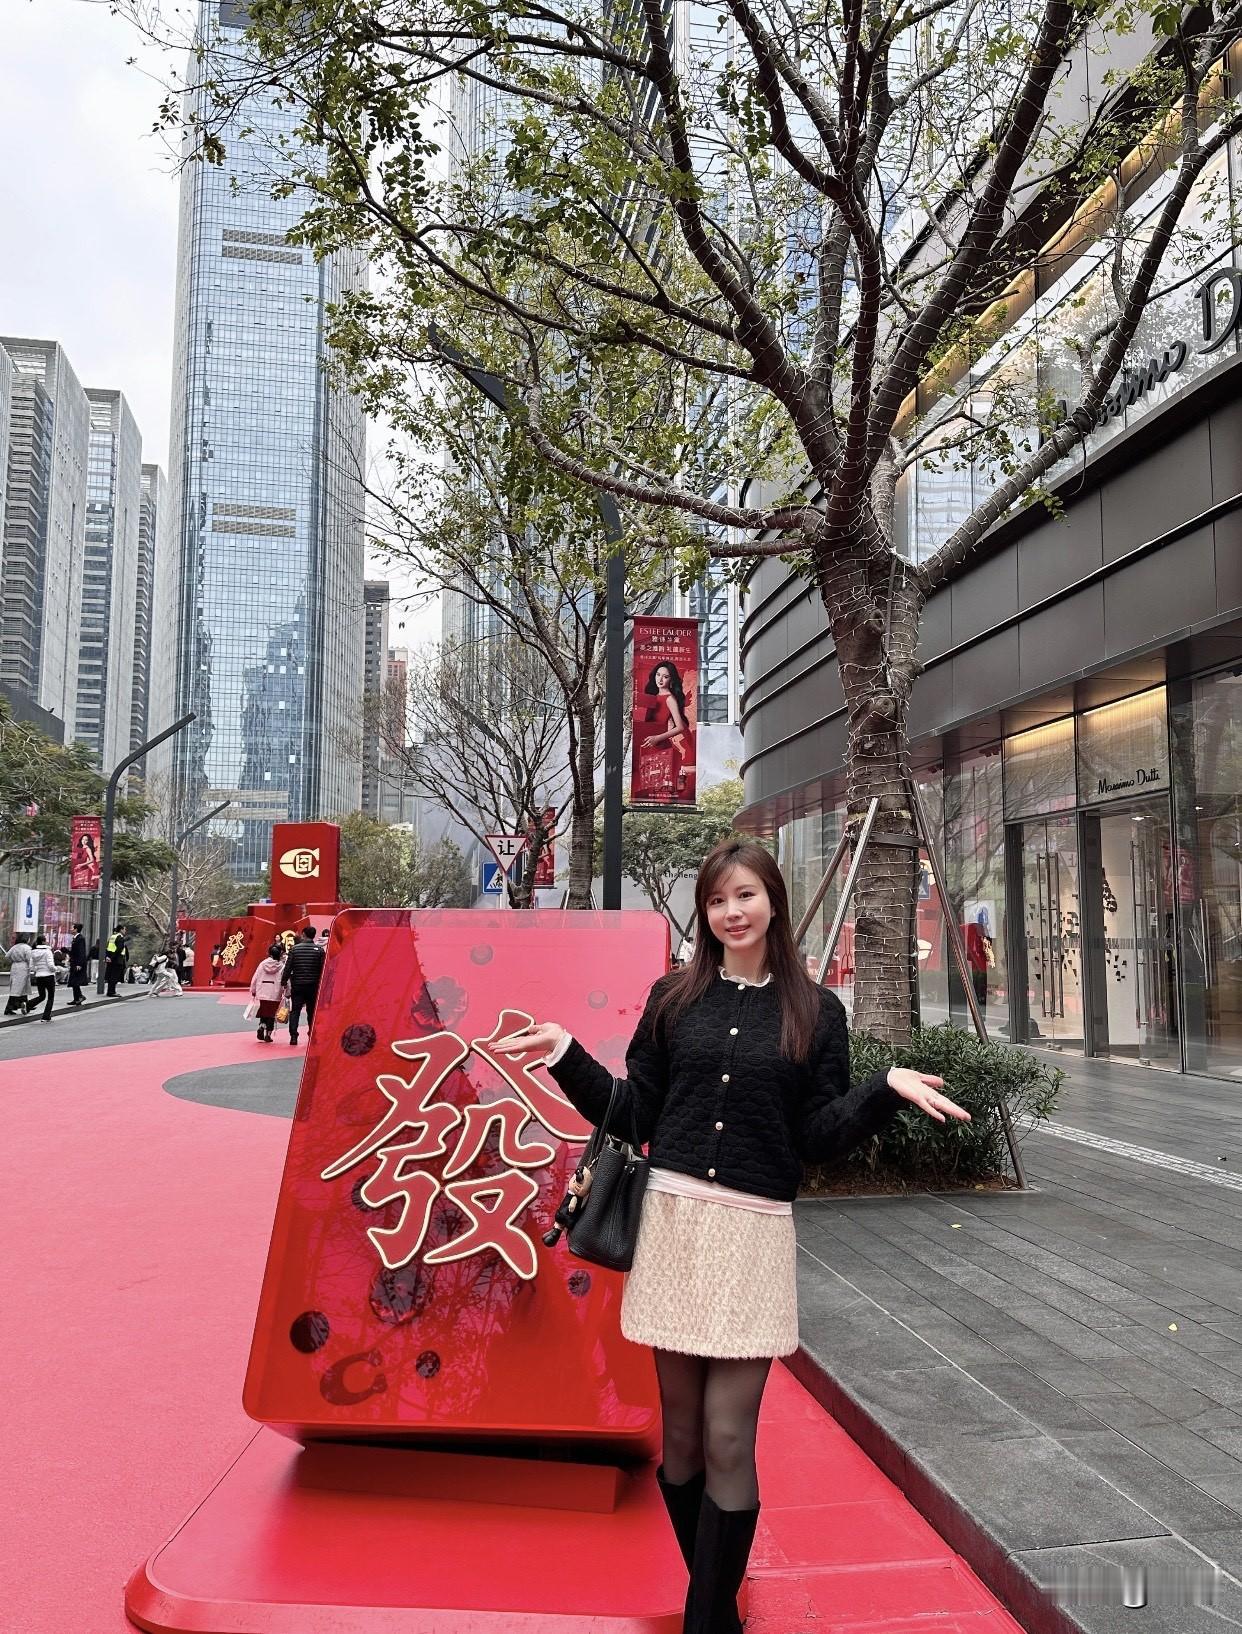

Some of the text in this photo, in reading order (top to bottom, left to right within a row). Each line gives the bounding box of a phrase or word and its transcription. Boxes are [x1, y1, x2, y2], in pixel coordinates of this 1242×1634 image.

[663, 628, 692, 637] LAUDER
[1098, 768, 1160, 794] Massimo Dutti
[497, 840, 515, 855] 让
[320, 1008, 592, 1280] 發
